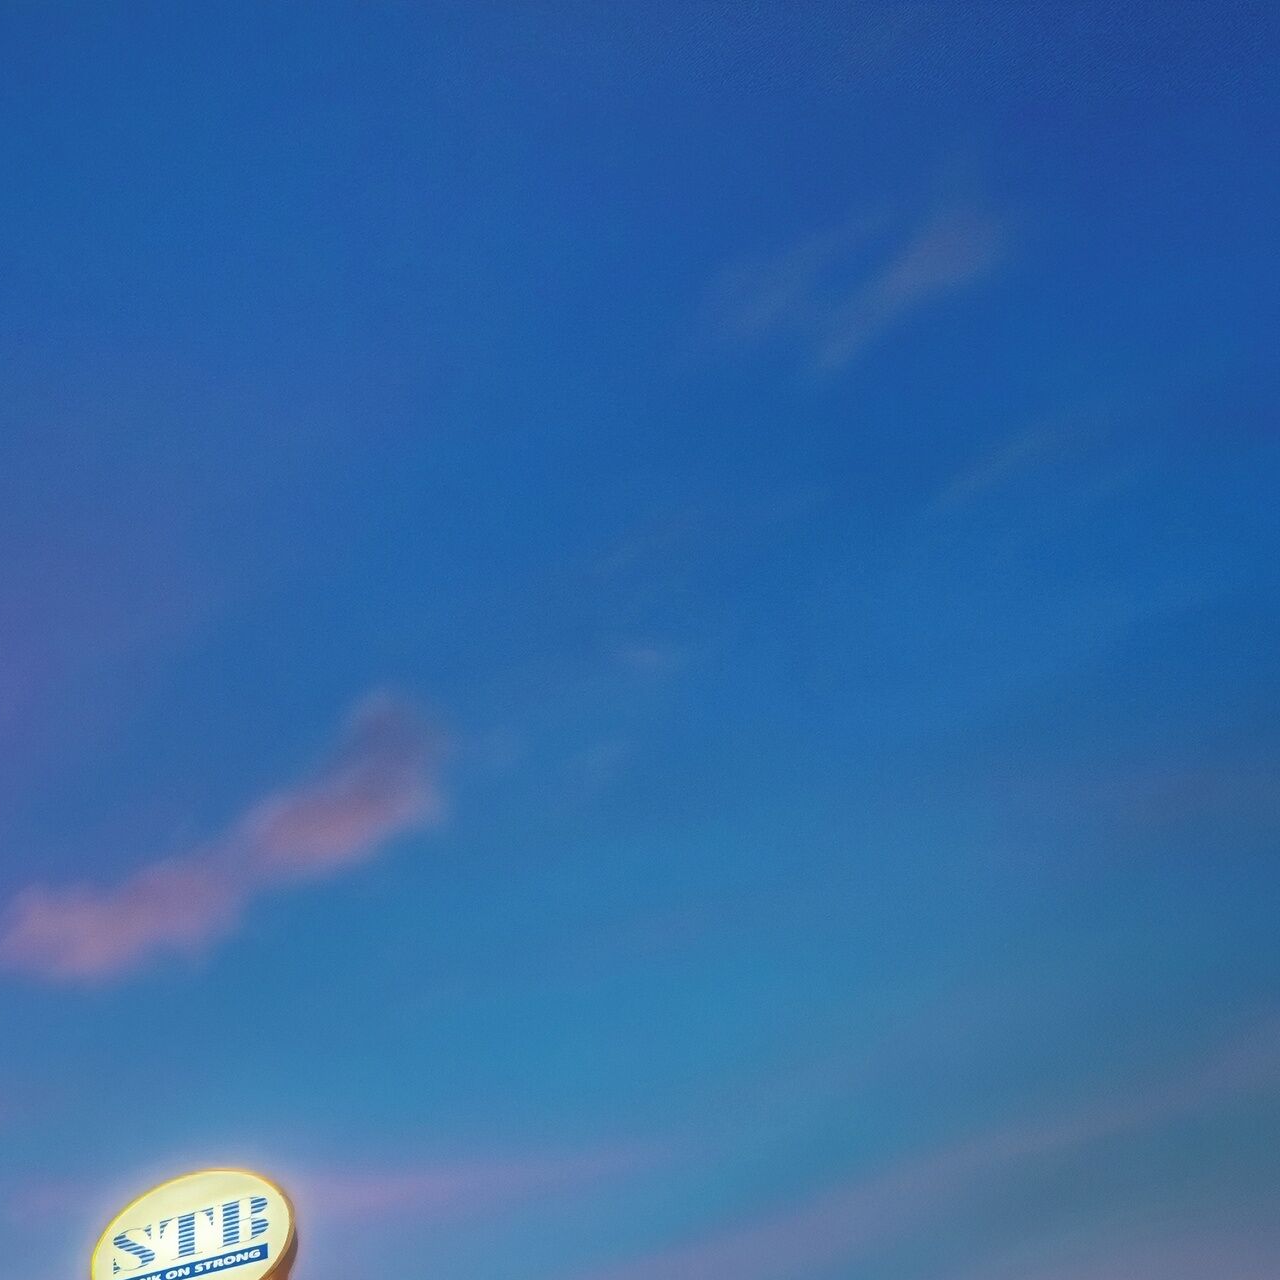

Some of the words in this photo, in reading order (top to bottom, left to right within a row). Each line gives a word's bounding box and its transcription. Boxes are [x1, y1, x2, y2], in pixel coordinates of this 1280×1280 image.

[112, 1196, 269, 1275] STB
[165, 1266, 190, 1280] ON
[194, 1248, 261, 1273] STRONG
